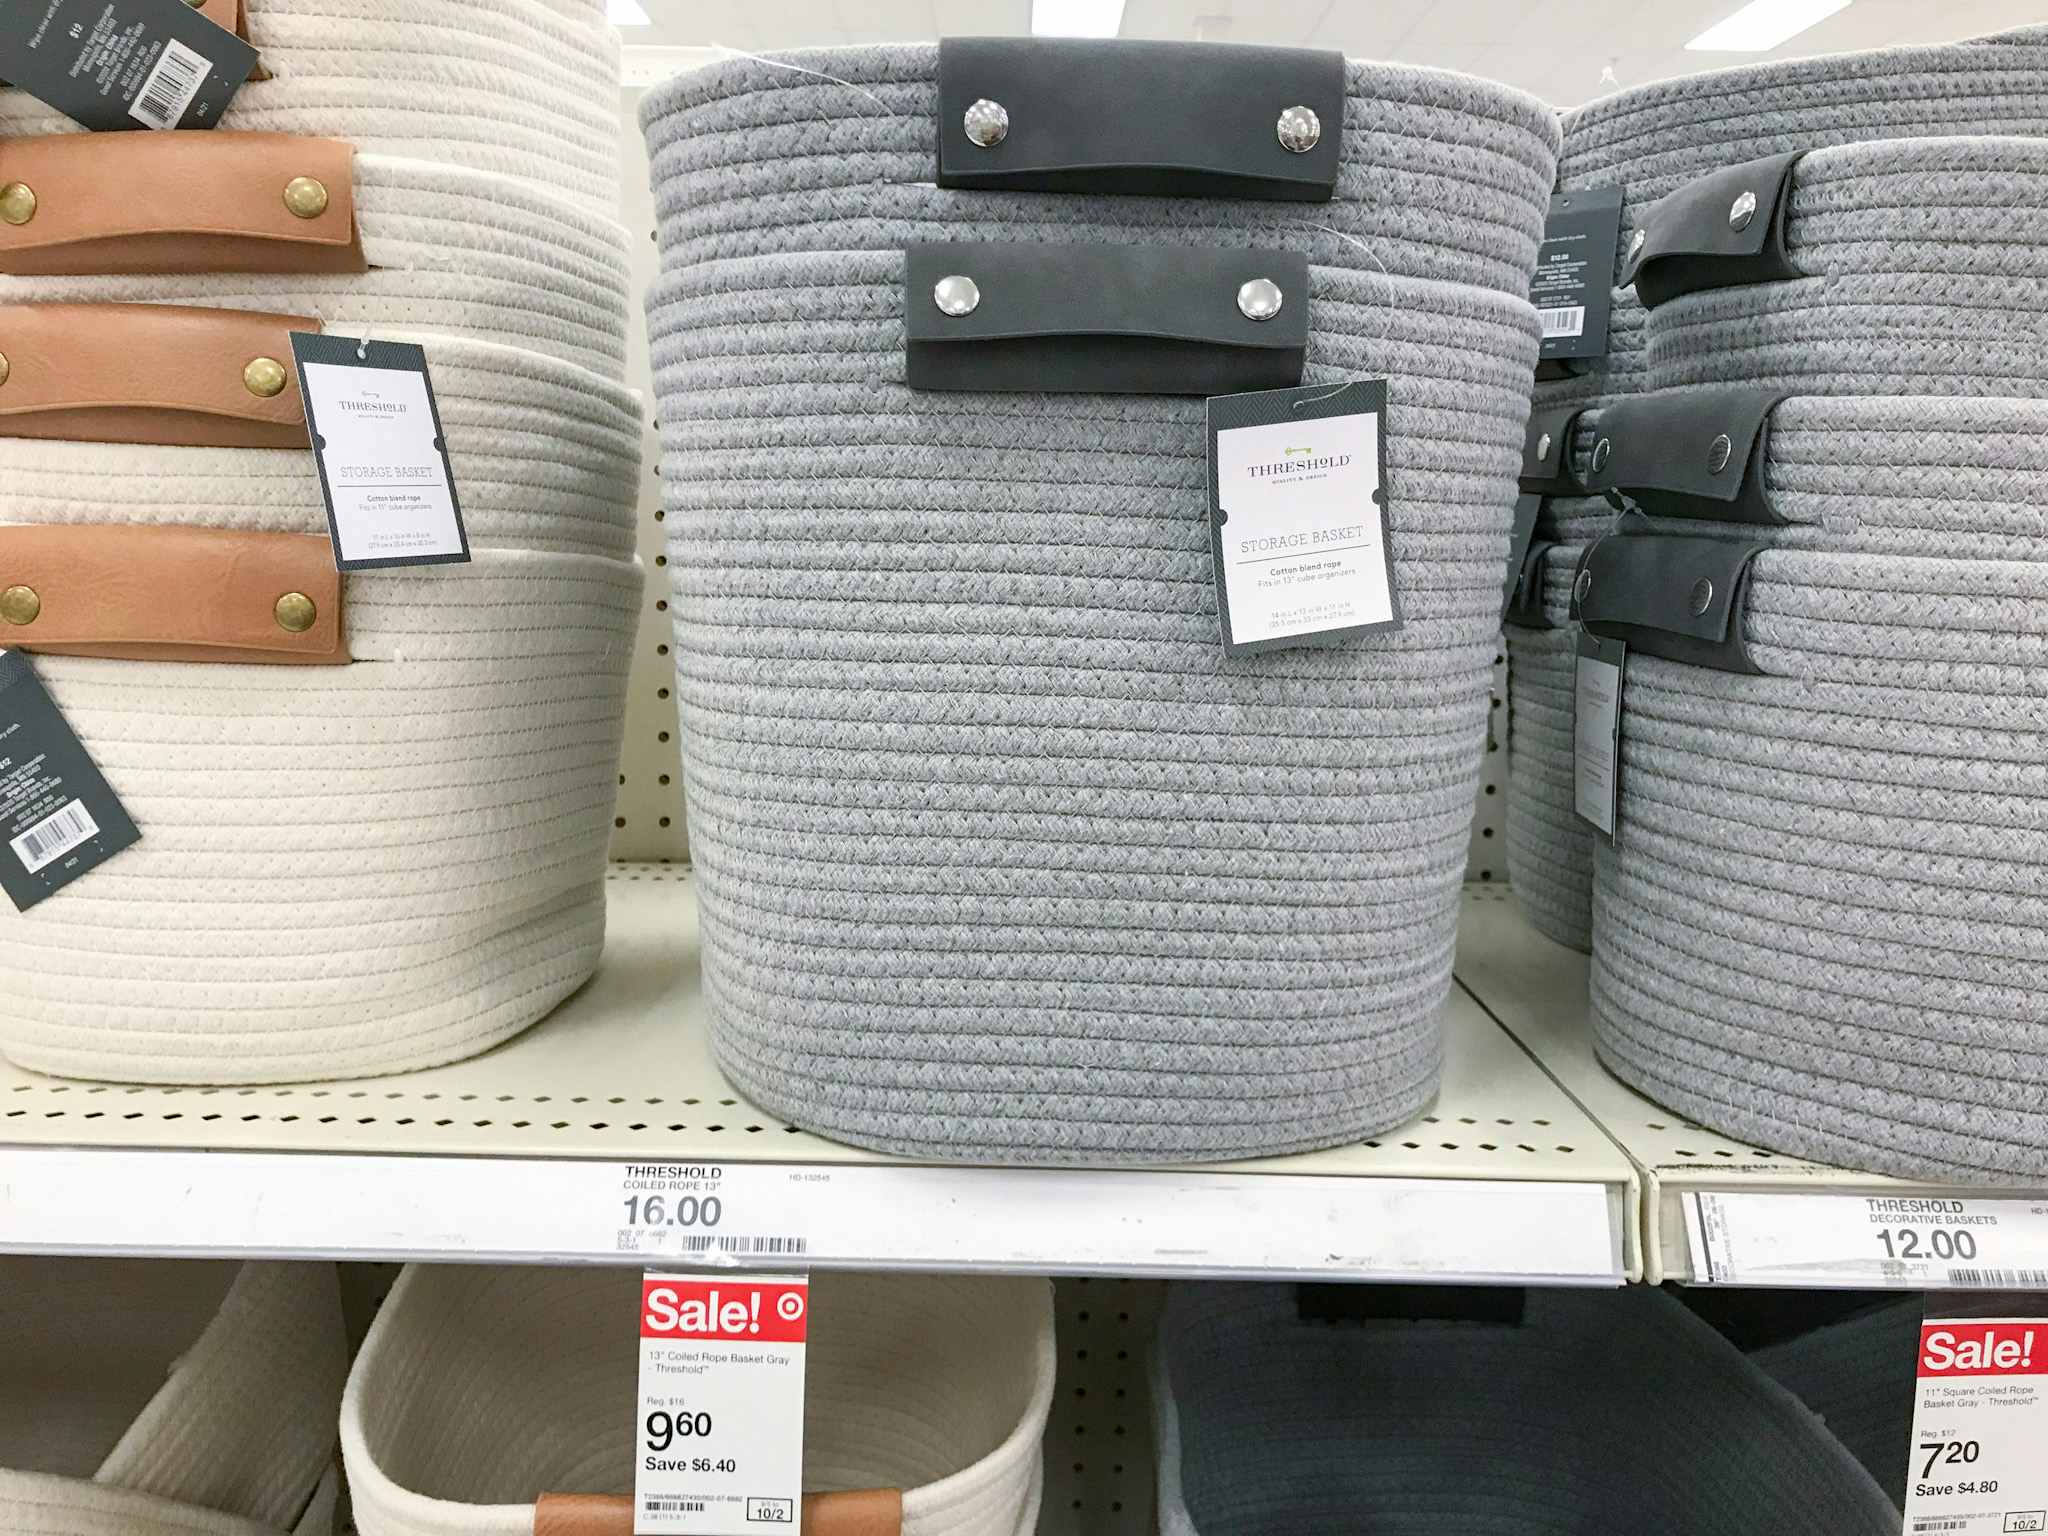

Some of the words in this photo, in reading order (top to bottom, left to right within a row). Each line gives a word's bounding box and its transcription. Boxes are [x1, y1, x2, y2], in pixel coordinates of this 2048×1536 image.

[68, 22, 85, 39] $12
[340, 466, 393, 479] STORAGE
[395, 466, 433, 479] BASKET
[1240, 533, 1308, 554] STORAGE
[1312, 525, 1364, 544] BASKET
[1270, 565, 1298, 577] Cotton
[1299, 562, 1322, 573] blend
[1323, 560, 1342, 572] rope
[625, 1166, 722, 1179] THRESHOLD
[623, 1181, 666, 1190] COILED
[669, 1181, 701, 1191] ROPE
[704, 1182, 721, 1191] 13"
[623, 1195, 722, 1227] 16.00
[1866, 1199, 1964, 1214] THRESHOLD
[1869, 1213, 1944, 1225] DECORATIVE
[1946, 1214, 1998, 1226] BASKETS
[1876, 1229, 1977, 1260] 12.00
[645, 1287, 761, 1334] Sale!
[1923, 1330, 2035, 1370] Sale!
[649, 1351, 665, 1361] 13"
[667, 1352, 699, 1361] Coiled
[702, 1353, 728, 1363] Rope
[730, 1354, 764, 1364] Basket
[766, 1355, 791, 1366] Gray
[1943, 1388, 1975, 1397] Square
[1977, 1386, 2007, 1395] Coiled
[2009, 1386, 2034, 1395] Rope
[669, 1397, 685, 1406] $16
[1924, 1399, 1955, 1409] Basket
[1957, 1400, 1979, 1409] Gray
[645, 1457, 687, 1472] Save
[692, 1458, 736, 1473] $6.40
[1916, 1484, 1953, 1497] Save
[1957, 1481, 1998, 1494] $4.80
[757, 1508, 784, 1520] 10/2
[2012, 1520, 2037, 1530] 10/2
